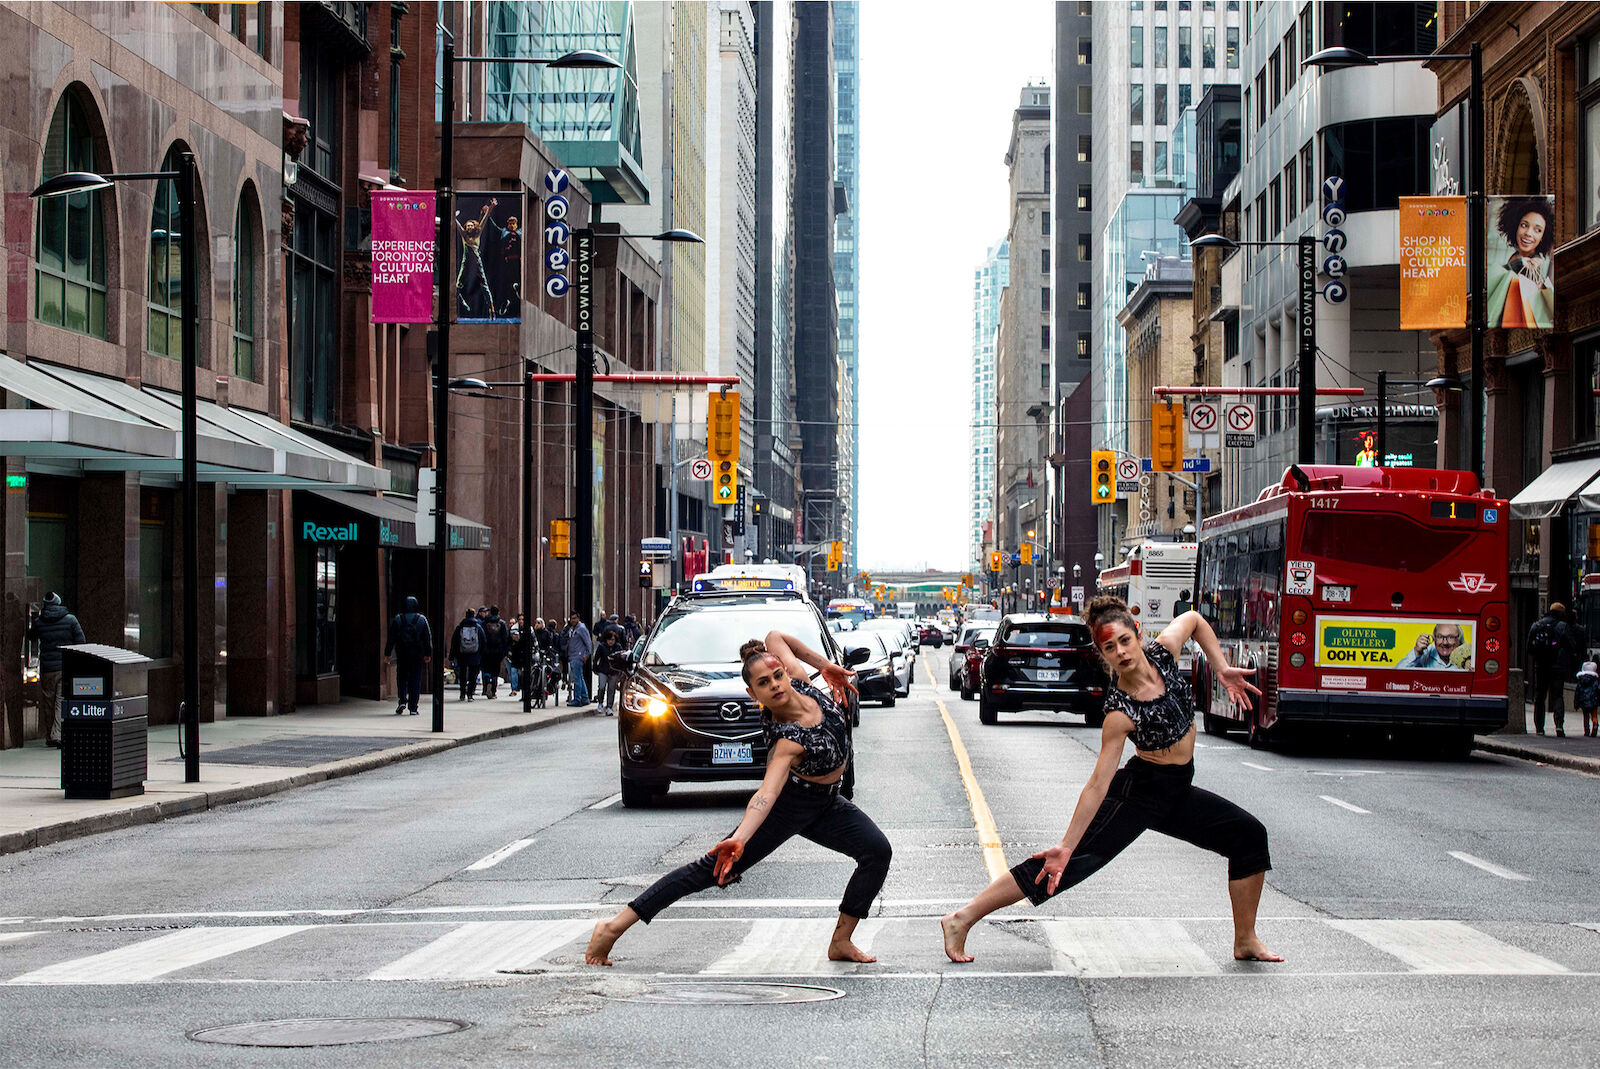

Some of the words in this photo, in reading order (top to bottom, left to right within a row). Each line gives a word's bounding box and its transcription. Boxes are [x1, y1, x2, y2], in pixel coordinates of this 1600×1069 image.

[545, 170, 569, 298] Yonge
[371, 240, 435, 251] EXPERIENCE
[1323, 176, 1347, 305] Yonge
[1403, 236, 1436, 246] SHOP
[1438, 235, 1451, 245] IN
[371, 251, 434, 262] TORONTO'S
[1400, 246, 1465, 257] TORONTO'S
[379, 262, 434, 272] CULTURAL
[1409, 257, 1467, 267] CULTURAL
[373, 273, 410, 283] HEART
[1402, 268, 1441, 278] HEART
[580, 238, 589, 331] DOWNTOWN
[1304, 245, 1312, 337] DOWNTOWN
[1140, 471, 1150, 520] ORNO
[1310, 498, 1340, 509] 1417
[1449, 502, 1456, 519] 1
[303, 521, 358, 542] Rexall
[1073, 592, 1084, 600] 40
[1341, 629, 1378, 638] OLIVER
[1331, 637, 1388, 647] JEWELLERY
[1327, 650, 1356, 661] OOH
[1360, 651, 1393, 662] YEA.
[82, 704, 107, 716] Litter
